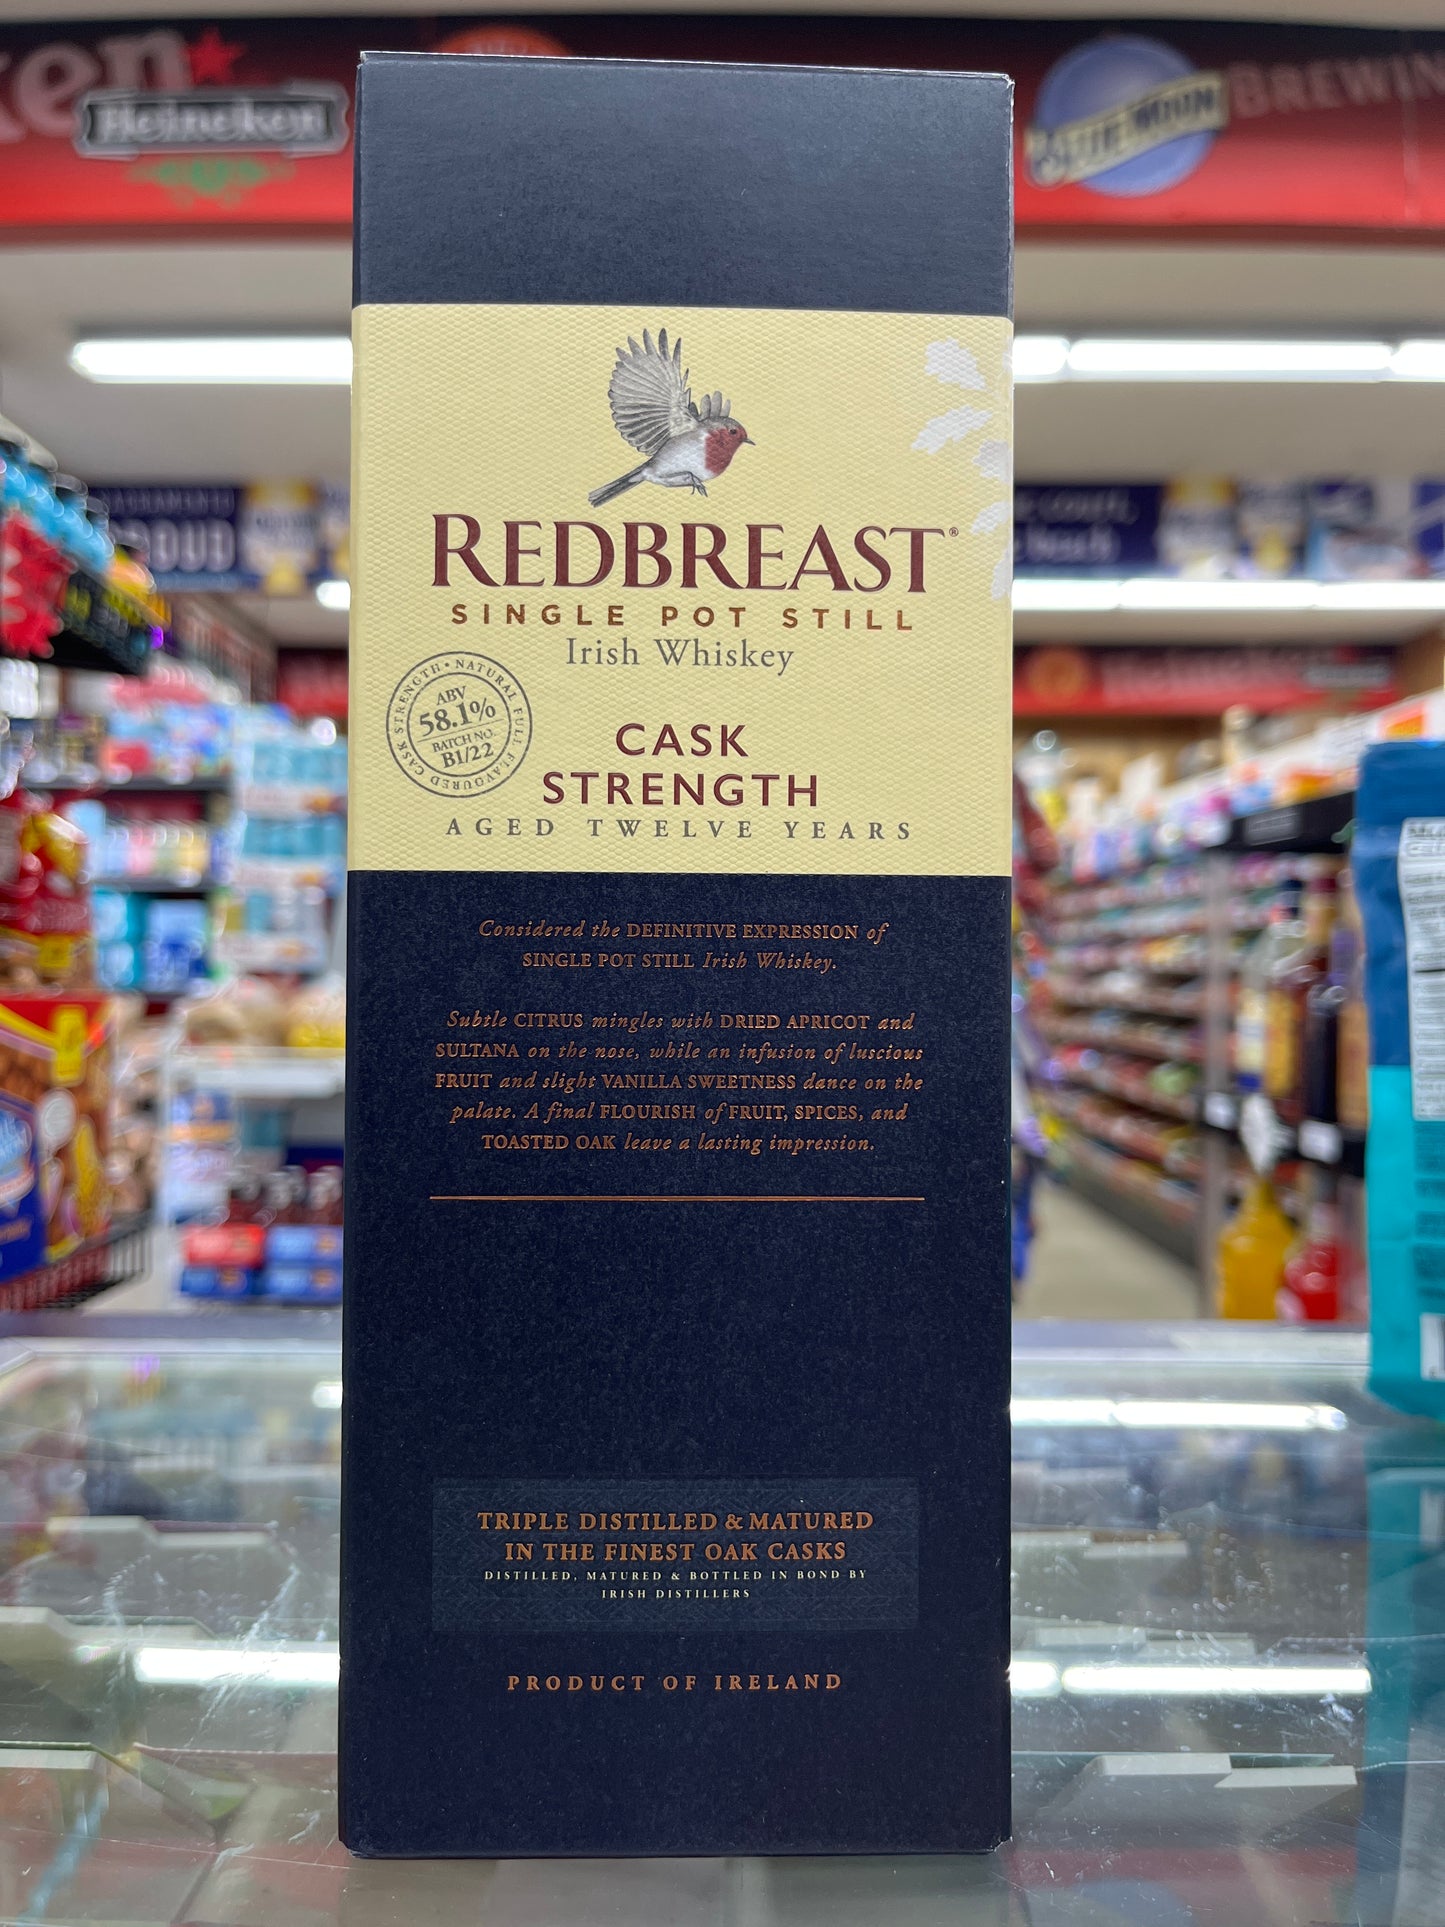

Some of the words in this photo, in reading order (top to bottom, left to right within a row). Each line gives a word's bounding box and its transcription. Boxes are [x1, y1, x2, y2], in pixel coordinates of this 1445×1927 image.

[94, 100, 326, 142] Heineken
[451, 604, 625, 626] SINGLE
[662, 607, 748, 628] POT
[783, 608, 914, 632] STILL
[566, 638, 639, 667] Irish
[654, 639, 795, 676] Whiskey
[456, 659, 517, 702] NATURAL
[395, 663, 440, 733] STRENGTH
[437, 686, 466, 705] ABV
[419, 698, 496, 737] 58.1%
[432, 734, 471, 753] BATCH
[475, 728, 496, 741] NO.
[615, 723, 749, 758] CASK
[397, 740, 425, 775] CASK
[441, 743, 494, 768] B1/22
[430, 753, 516, 790] FLAVOURED
[542, 772, 818, 807] STRENGTH
[446, 818, 555, 837] AGED
[588, 819, 753, 839] TWELVE
[785, 821, 911, 841] YEARS
[479, 919, 585, 939] Considered
[591, 920, 621, 939] the
[626, 923, 737, 939] DEFINITIVE
[743, 924, 859, 940] EXPRESSION
[866, 922, 890, 944] of
[522, 953, 591, 968] SINGLE
[598, 953, 635, 968] POT
[642, 953, 695, 968] STILL
[702, 953, 747, 969] Irish
[756, 953, 838, 974] Whiskey.
[447, 1010, 508, 1028] Subtle
[513, 1013, 584, 1028] CITRUS
[591, 1013, 664, 1033] mingles
[670, 1012, 713, 1030] with
[720, 1014, 781, 1030] DRIED
[786, 1015, 870, 1030] APRICOT
[877, 1013, 916, 1031] and
[435, 1043, 520, 1058] SULTANA
[527, 1046, 550, 1058] on
[557, 1042, 588, 1059] the
[594, 1047, 641, 1062] nose,
[649, 1042, 701, 1060] while
[707, 1047, 731, 1060] an
[738, 1044, 816, 1064] infusion
[823, 1044, 846, 1064] of
[849, 1044, 924, 1060] luscious
[435, 1073, 492, 1088] FRUIT
[499, 1073, 537, 1089] and
[542, 1072, 596, 1094] slight
[601, 1074, 682, 1089] VANILLA
[687, 1074, 796, 1090] SWEETNESS
[803, 1073, 857, 1090] dance
[864, 1078, 886, 1090] on
[894, 1074, 924, 1091] the
[450, 1102, 517, 1124] palate.
[524, 1103, 539, 1119] A
[542, 1102, 595, 1124] final
[600, 1104, 696, 1120] FLOURISH
[703, 1102, 727, 1124] of
[728, 1105, 789, 1122] FRUIT,
[794, 1105, 864, 1123] SPICES,
[870, 1104, 908, 1121] and
[481, 1134, 569, 1149] TOASTED
[575, 1135, 617, 1150] OAK
[623, 1133, 671, 1150] leave
[678, 1138, 691, 1150] a
[697, 1134, 762, 1155] lasting
[769, 1134, 875, 1155] impression.
[477, 1512, 569, 1530] TRIPLE
[579, 1513, 718, 1530] DISTILLED
[724, 1514, 743, 1530] &
[748, 1511, 874, 1530] MATURED
[504, 1542, 533, 1560] IN
[543, 1543, 595, 1561] THE
[604, 1543, 695, 1561] FINEST
[705, 1543, 758, 1561] OAK
[767, 1542, 846, 1560] CASKS
[484, 1570, 578, 1582] DISTILLED,
[586, 1571, 662, 1581] MATURED
[670, 1571, 681, 1581] &
[690, 1570, 763, 1580] BOTTLED
[771, 1570, 788, 1580] IN
[797, 1570, 839, 1579] BOND
[849, 1569, 867, 1579] BY
[601, 1589, 647, 1599] IRISH
[656, 1588, 751, 1599] DISTILLERS
[508, 1674, 645, 1691] PRODUCT
[662, 1674, 697, 1690] OF
[714, 1673, 842, 1690] IRELAND
